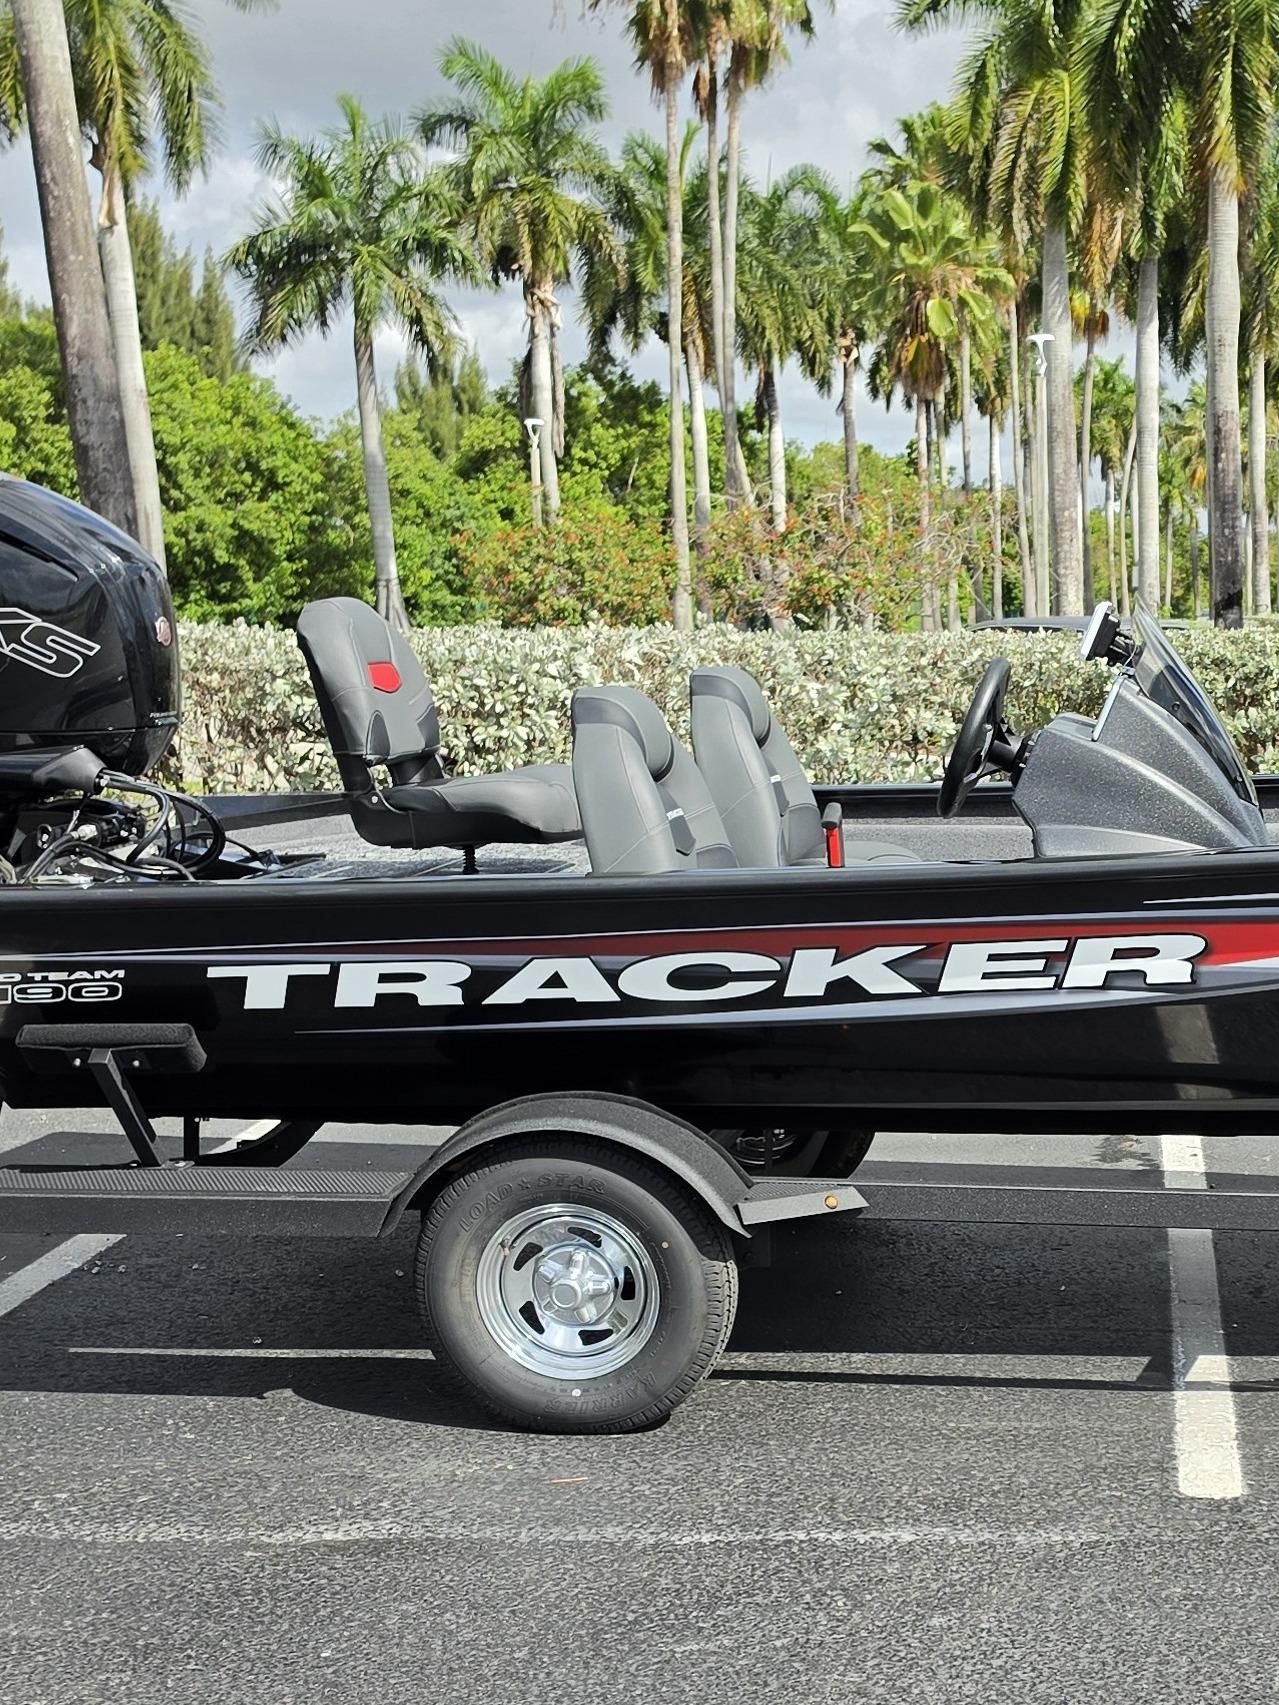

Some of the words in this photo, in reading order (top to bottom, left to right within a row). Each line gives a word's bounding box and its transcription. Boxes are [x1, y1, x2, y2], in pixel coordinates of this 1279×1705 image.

[26, 969, 126, 981] TEAM
[206, 934, 1207, 1010] TRACKER
[458, 1183, 513, 1232] LOAD
[537, 1173, 606, 1194] STAR
